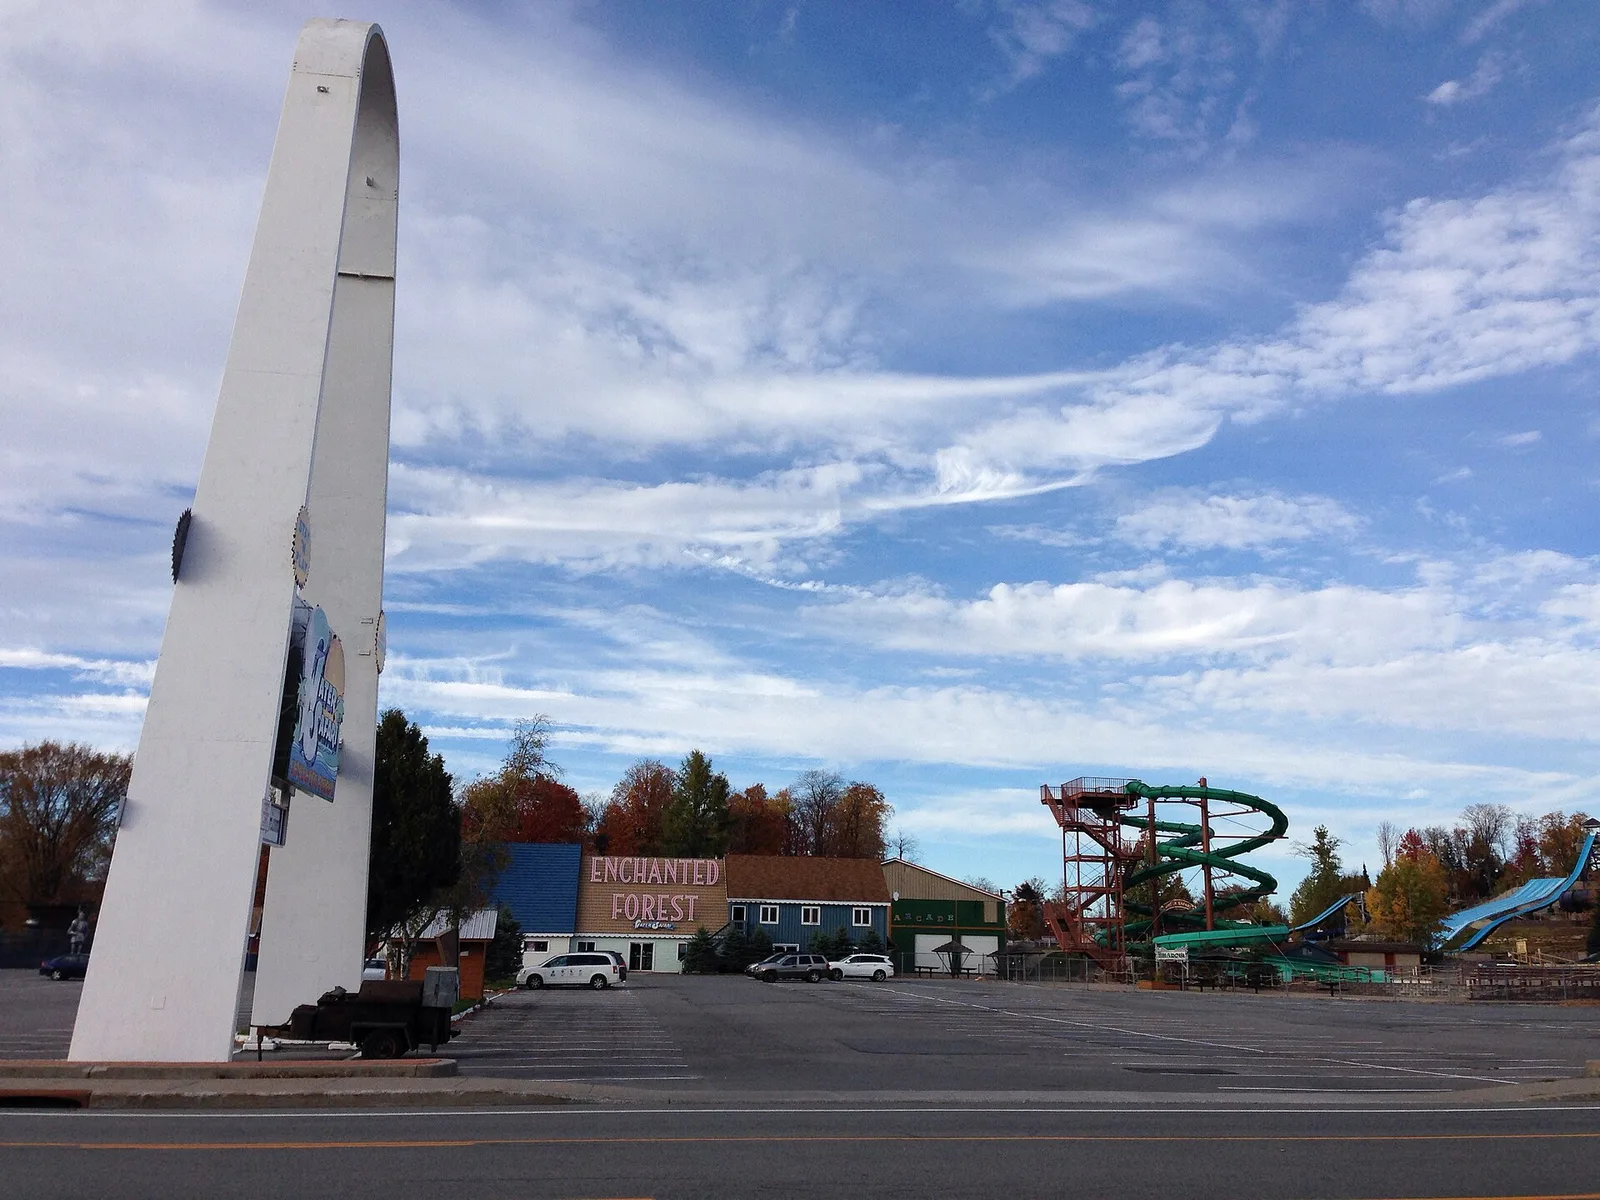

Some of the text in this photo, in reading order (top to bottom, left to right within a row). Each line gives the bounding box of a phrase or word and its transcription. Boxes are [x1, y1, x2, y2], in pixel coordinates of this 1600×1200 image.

[590, 856, 719, 886] ENCHANTED
[611, 893, 699, 922] FOREST
[894, 912, 954, 922] ARCADE
